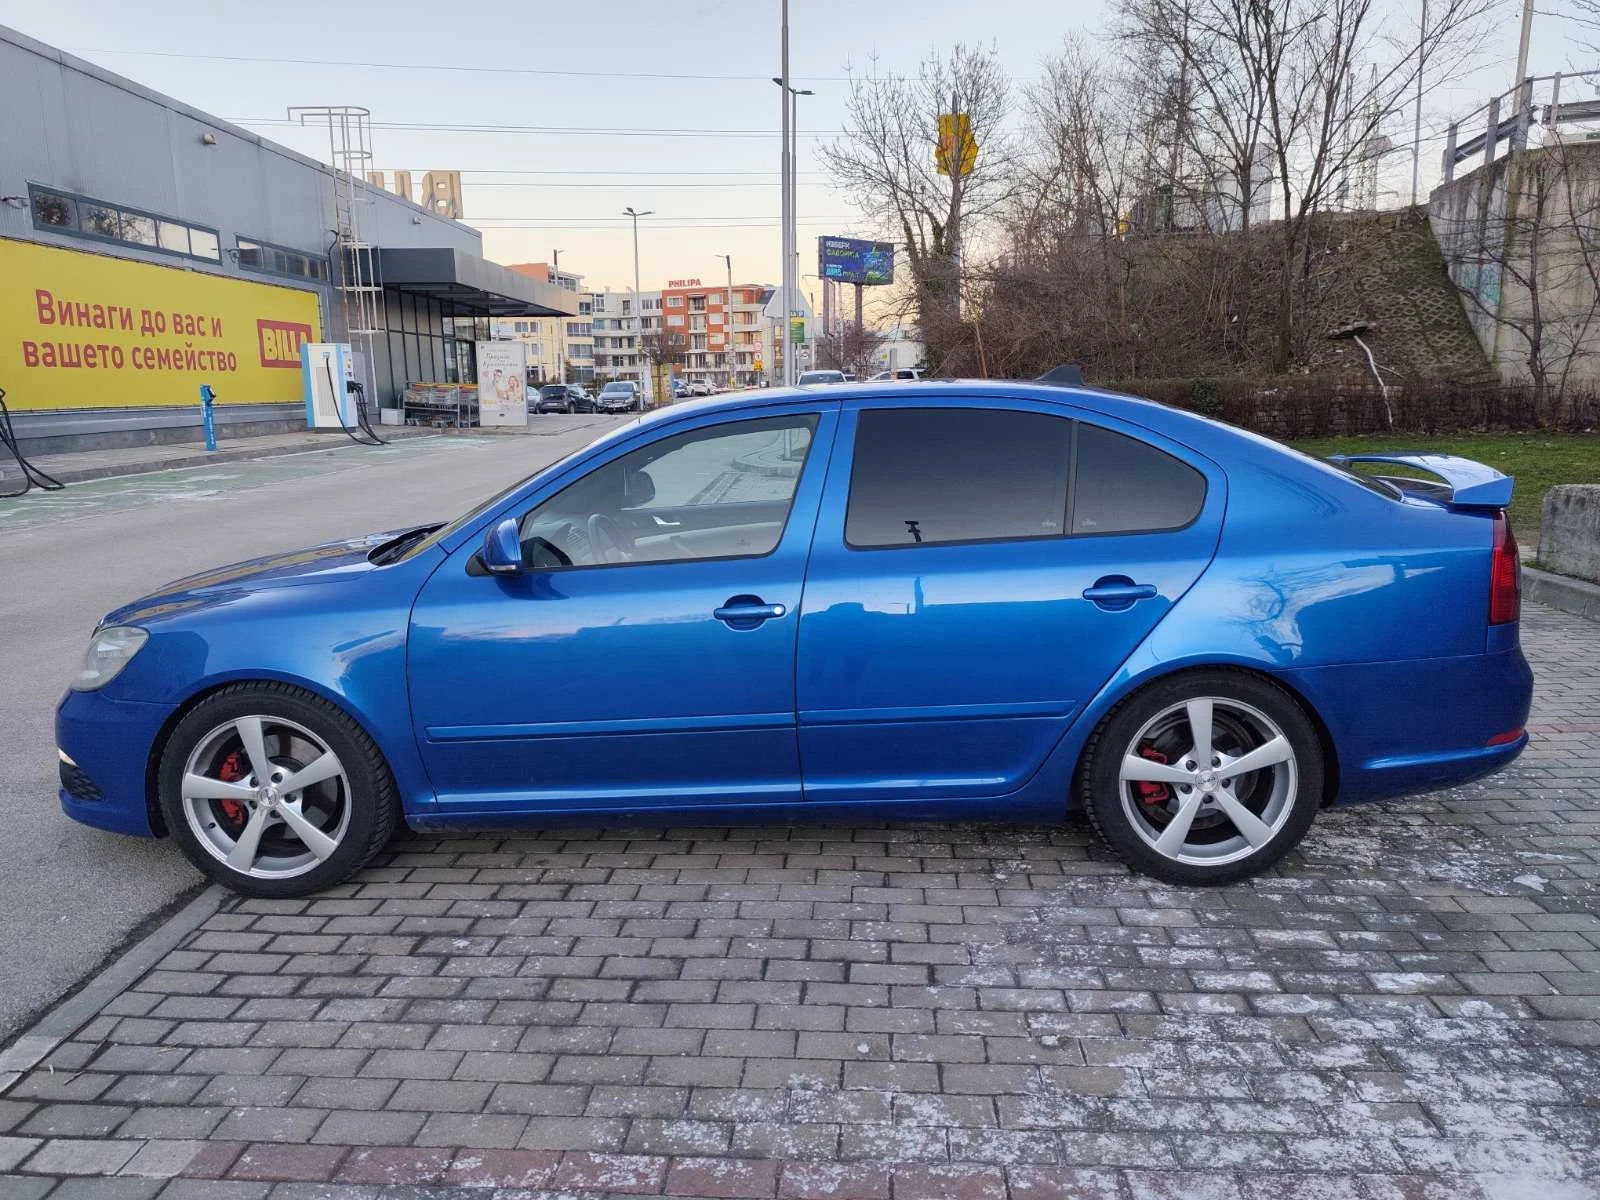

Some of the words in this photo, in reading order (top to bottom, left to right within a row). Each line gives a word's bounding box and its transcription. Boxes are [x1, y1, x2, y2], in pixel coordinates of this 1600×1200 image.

[668, 278, 702, 288] PHILIPA
[35, 288, 133, 331] Винаги
[140, 309, 166, 337] до
[172, 313, 206, 337] вас
[211, 317, 222, 338] и
[22, 341, 124, 369] вашето
[131, 341, 237, 372] семейство
